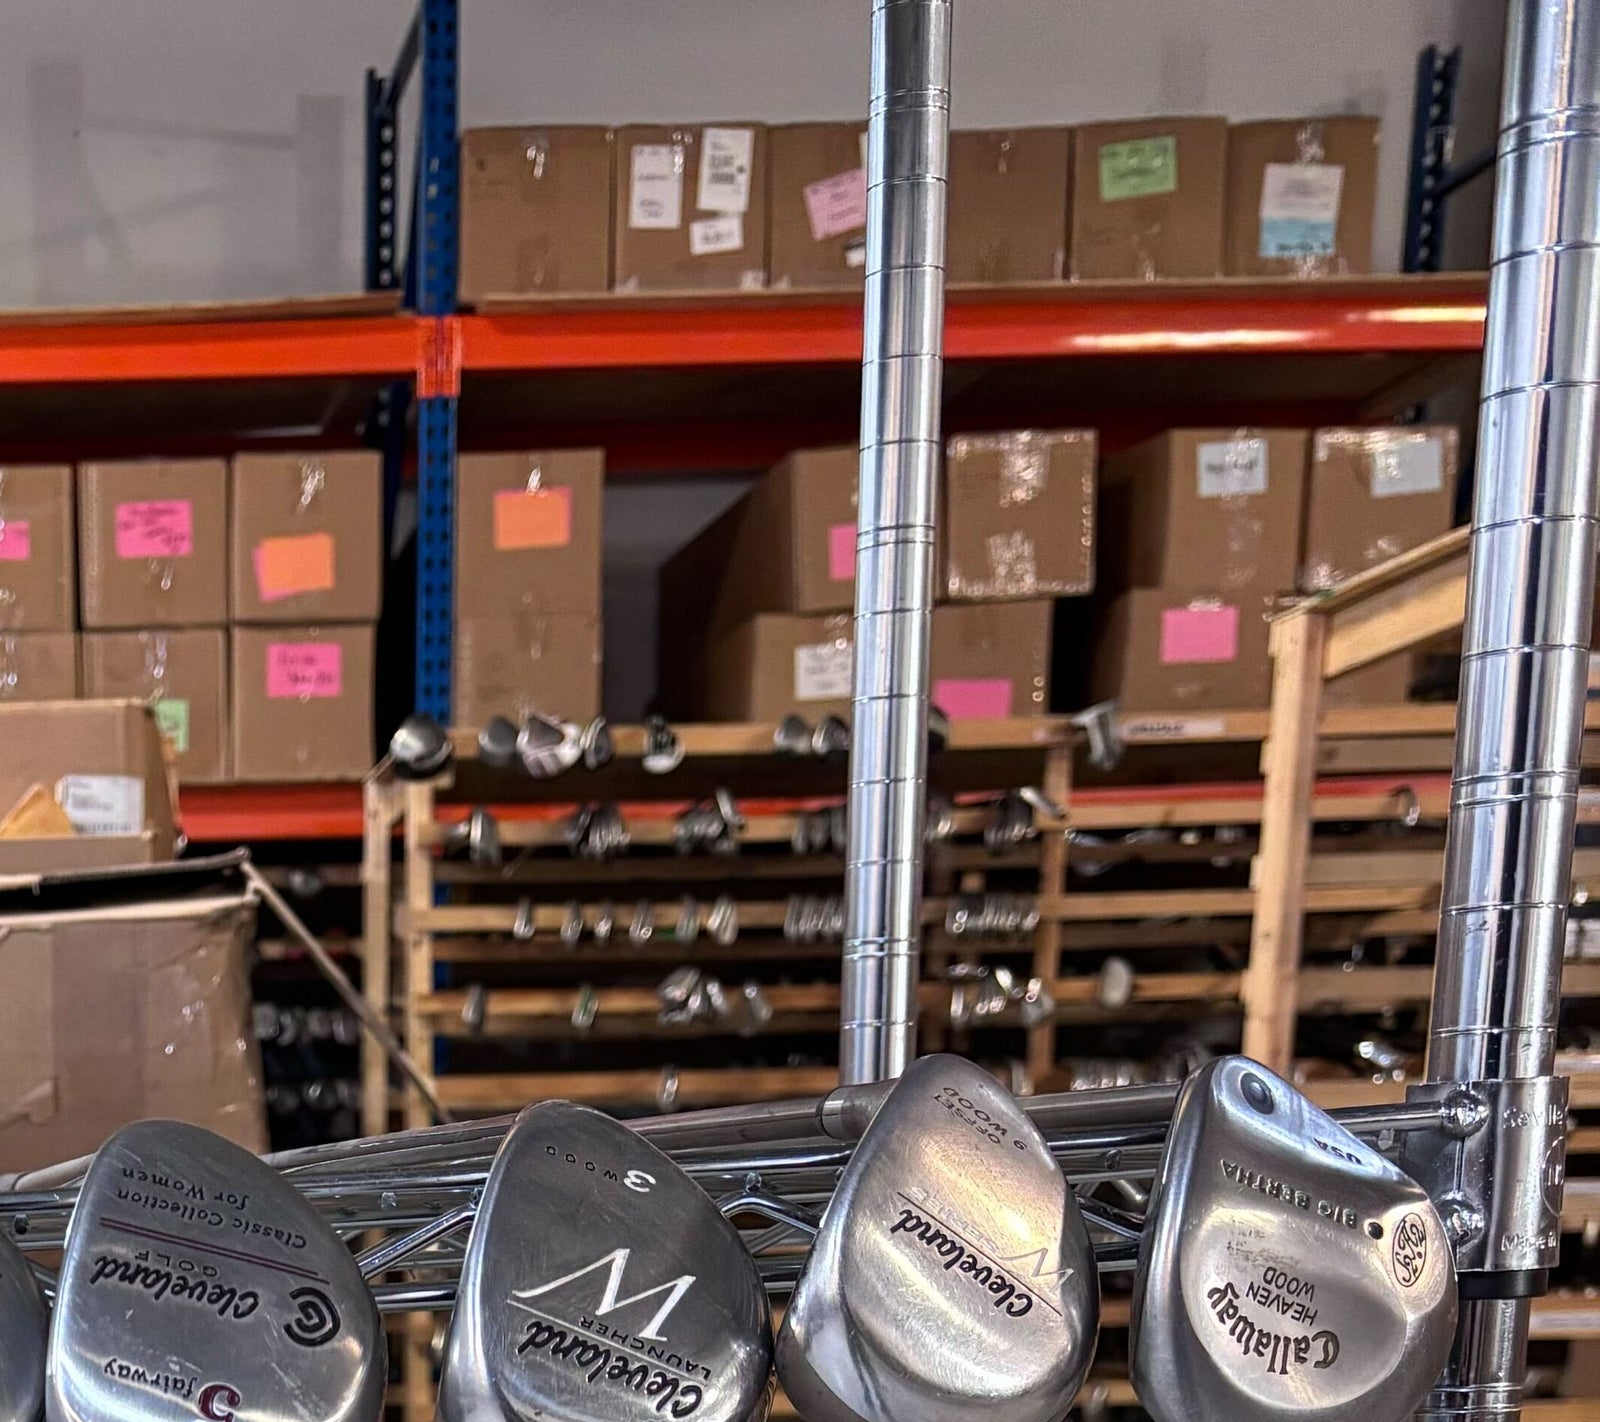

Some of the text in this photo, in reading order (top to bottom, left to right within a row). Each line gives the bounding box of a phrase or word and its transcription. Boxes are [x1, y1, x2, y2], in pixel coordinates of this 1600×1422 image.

[934, 1094, 1000, 1144] OFFSET
[943, 1087, 1008, 1137] WOOD
[545, 1145, 656, 1192] 3 WOOD
[1312, 1137, 1363, 1166] USA
[121, 1166, 249, 1212] for Women
[1220, 1159, 1358, 1229] BIG BERTHA
[116, 1187, 307, 1250] Classic Collection
[90, 1255, 260, 1320] Cleveland
[134, 1250, 218, 1278] GOLF
[889, 1208, 1034, 1318] Cleveland
[1262, 1266, 1315, 1302] WOOD
[511, 1247, 697, 1342] W
[1246, 1281, 1319, 1327] HEAVEN
[579, 1315, 713, 1380] LAUNCHER
[1207, 1281, 1341, 1376] Callaway
[103, 1357, 198, 1398] fairway
[516, 1320, 703, 1419] Cleveland
